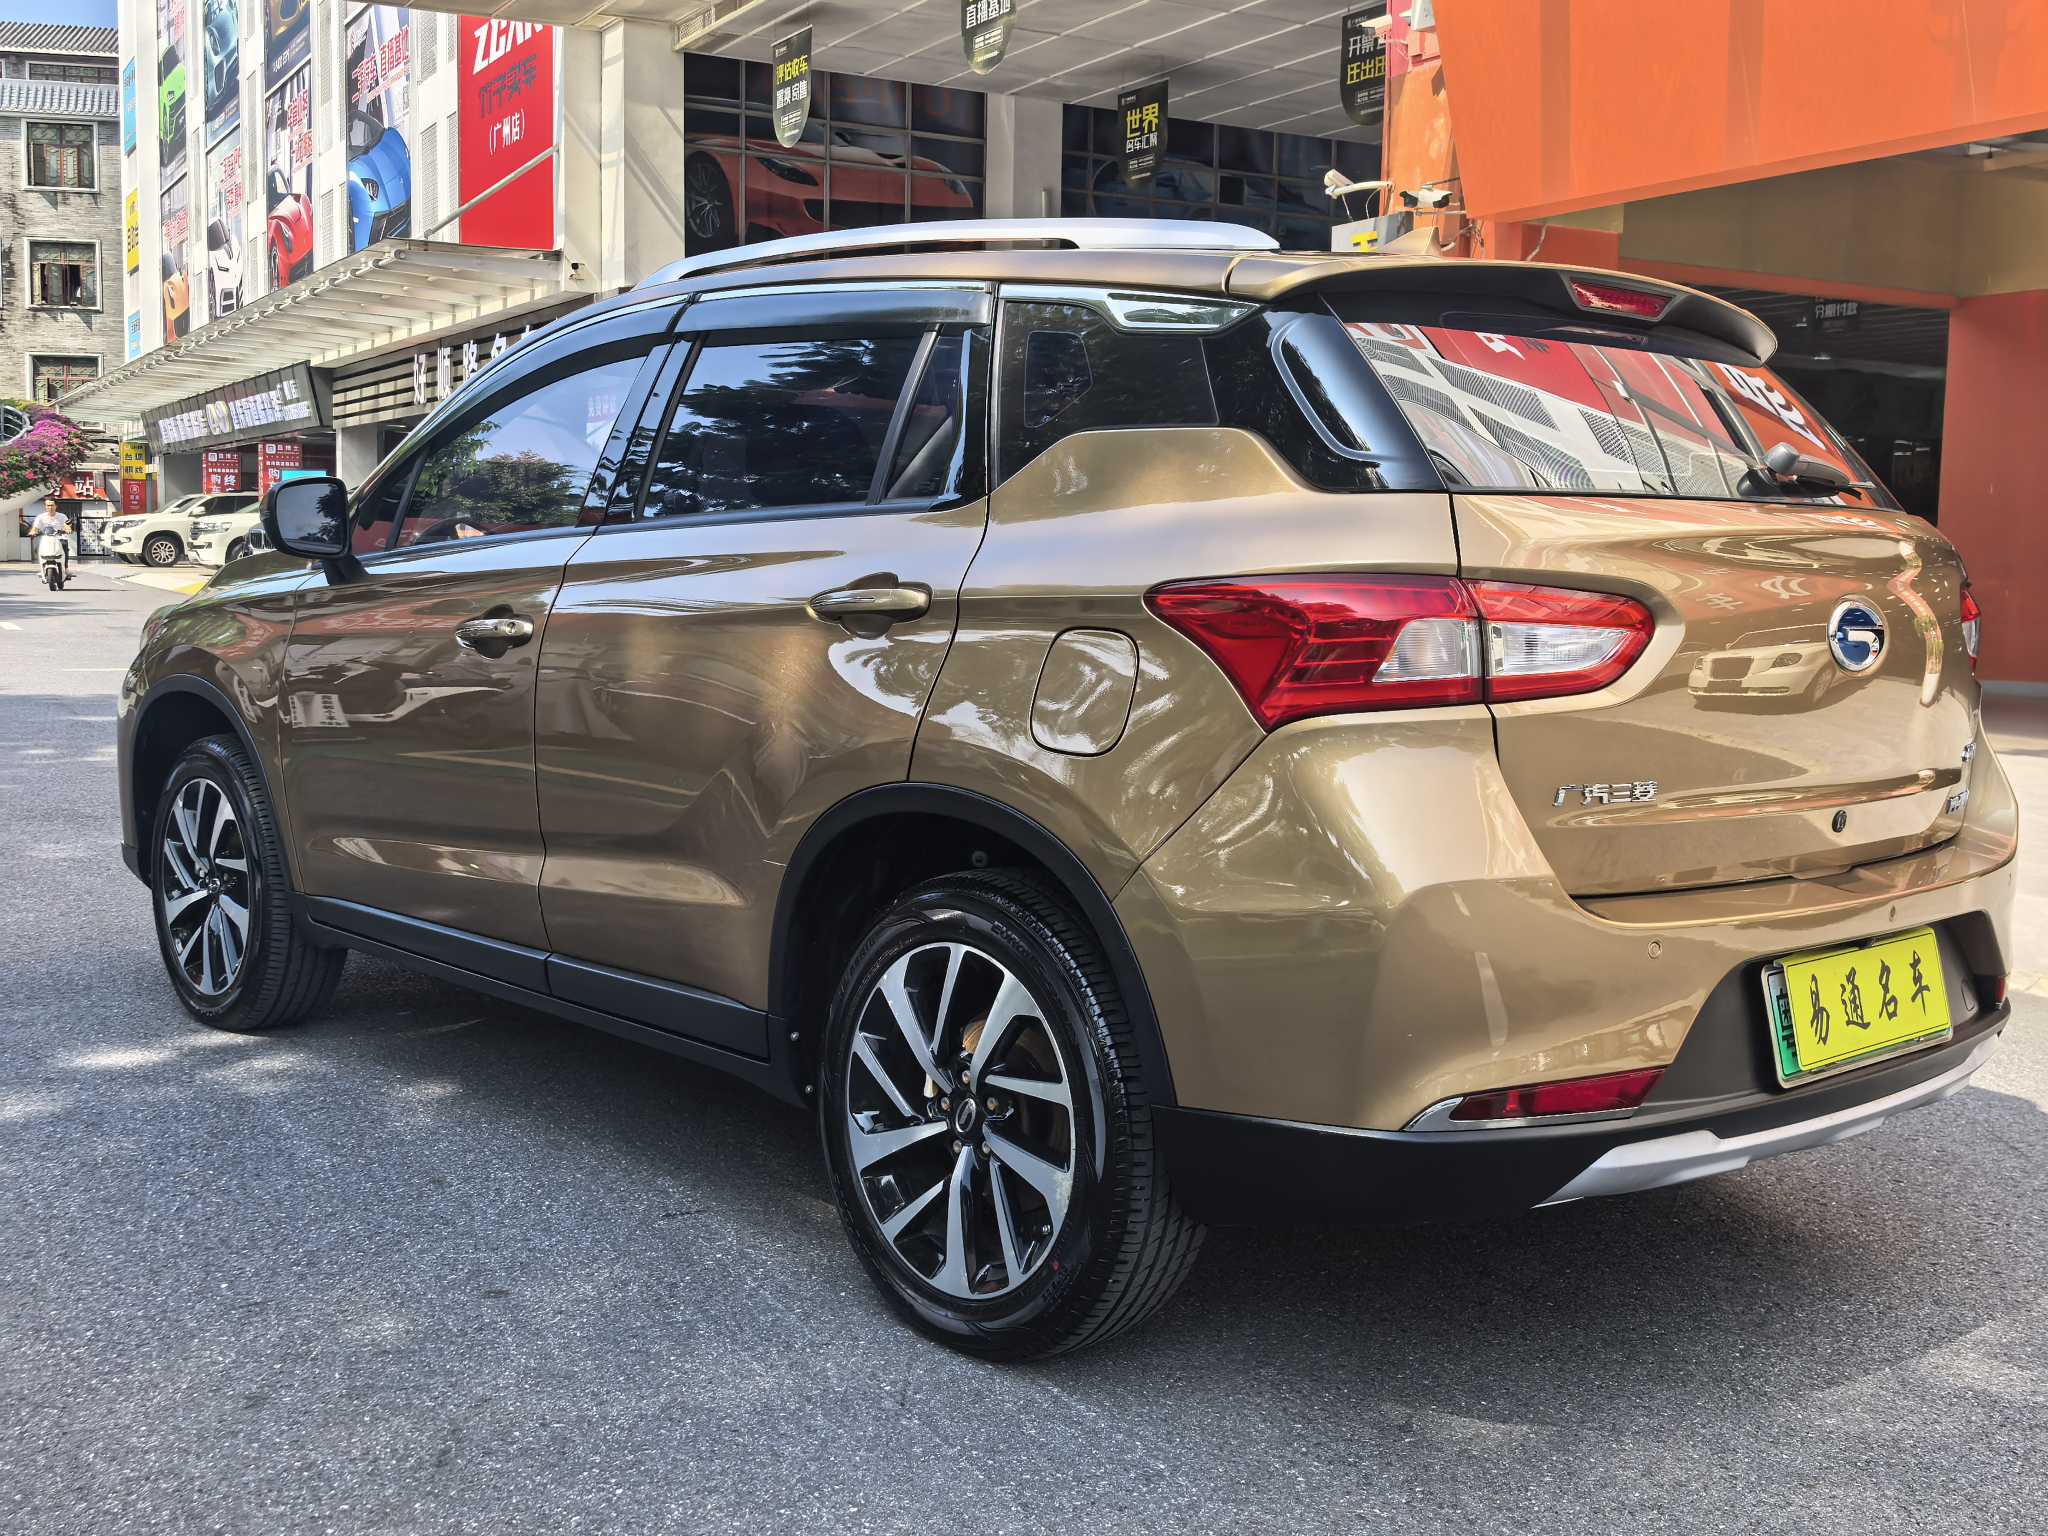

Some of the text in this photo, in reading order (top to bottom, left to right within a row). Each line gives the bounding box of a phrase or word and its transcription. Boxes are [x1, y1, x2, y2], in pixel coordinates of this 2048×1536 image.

[776, 54, 808, 85] 评估收车
[1126, 102, 1160, 139] 世界
[1553, 780, 1660, 807] 广汽三菱
[1809, 950, 1931, 1046] 易通名车
